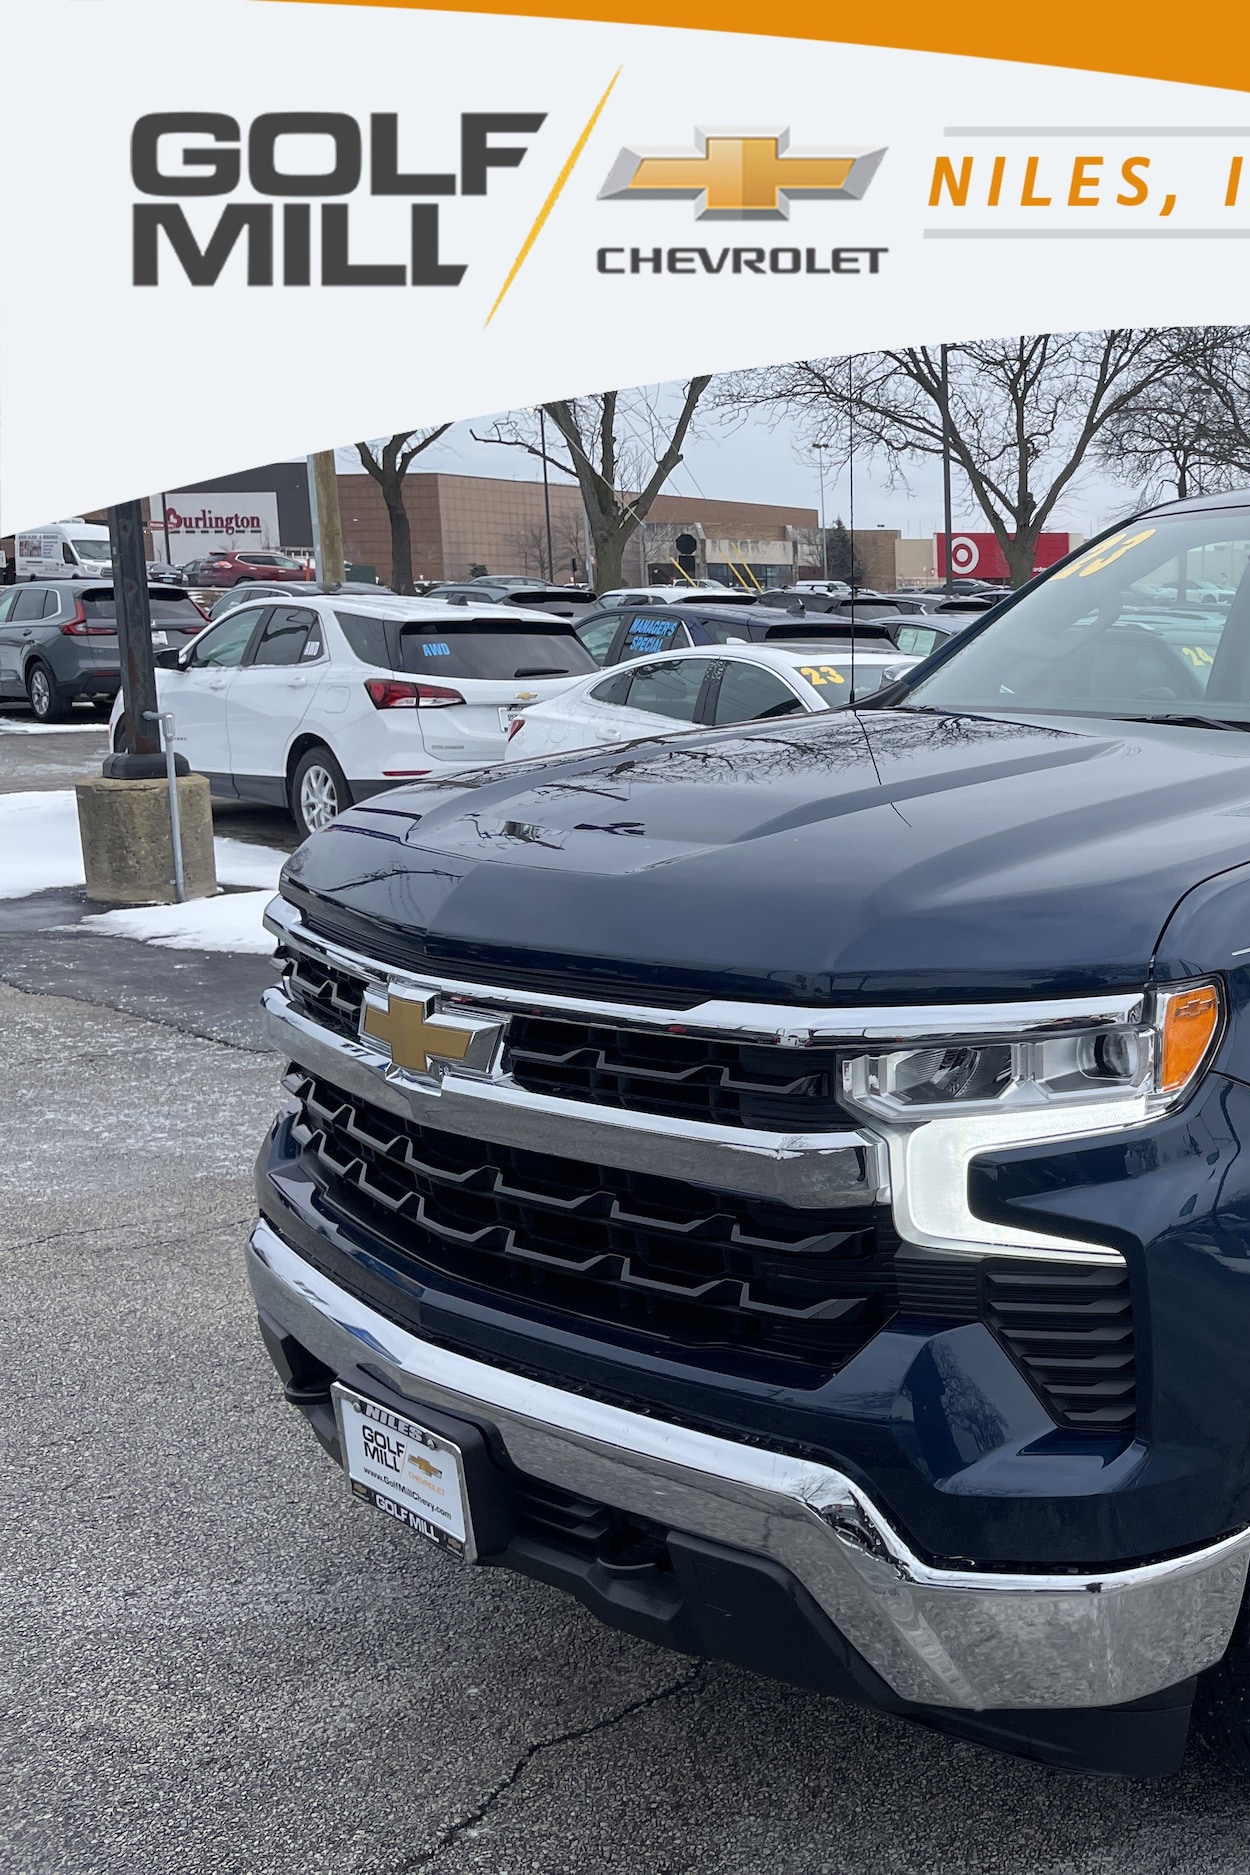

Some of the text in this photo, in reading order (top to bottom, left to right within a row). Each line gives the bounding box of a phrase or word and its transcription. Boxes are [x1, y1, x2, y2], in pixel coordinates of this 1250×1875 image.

[166, 507, 261, 535] Burlington
[629, 618, 678, 637] MANAGER'S
[422, 642, 451, 657] AWD
[630, 636, 663, 653] SPECIAL
[1182, 647, 1214, 666] 24
[800, 666, 845, 685] 23
[365, 1404, 423, 1442] NILES
[362, 1424, 405, 1457] GOLF
[364, 1441, 401, 1473] MILL
[364, 1466, 452, 1520] www.GolfMillChevy.com
[375, 1494, 440, 1543] GOLF MILL
